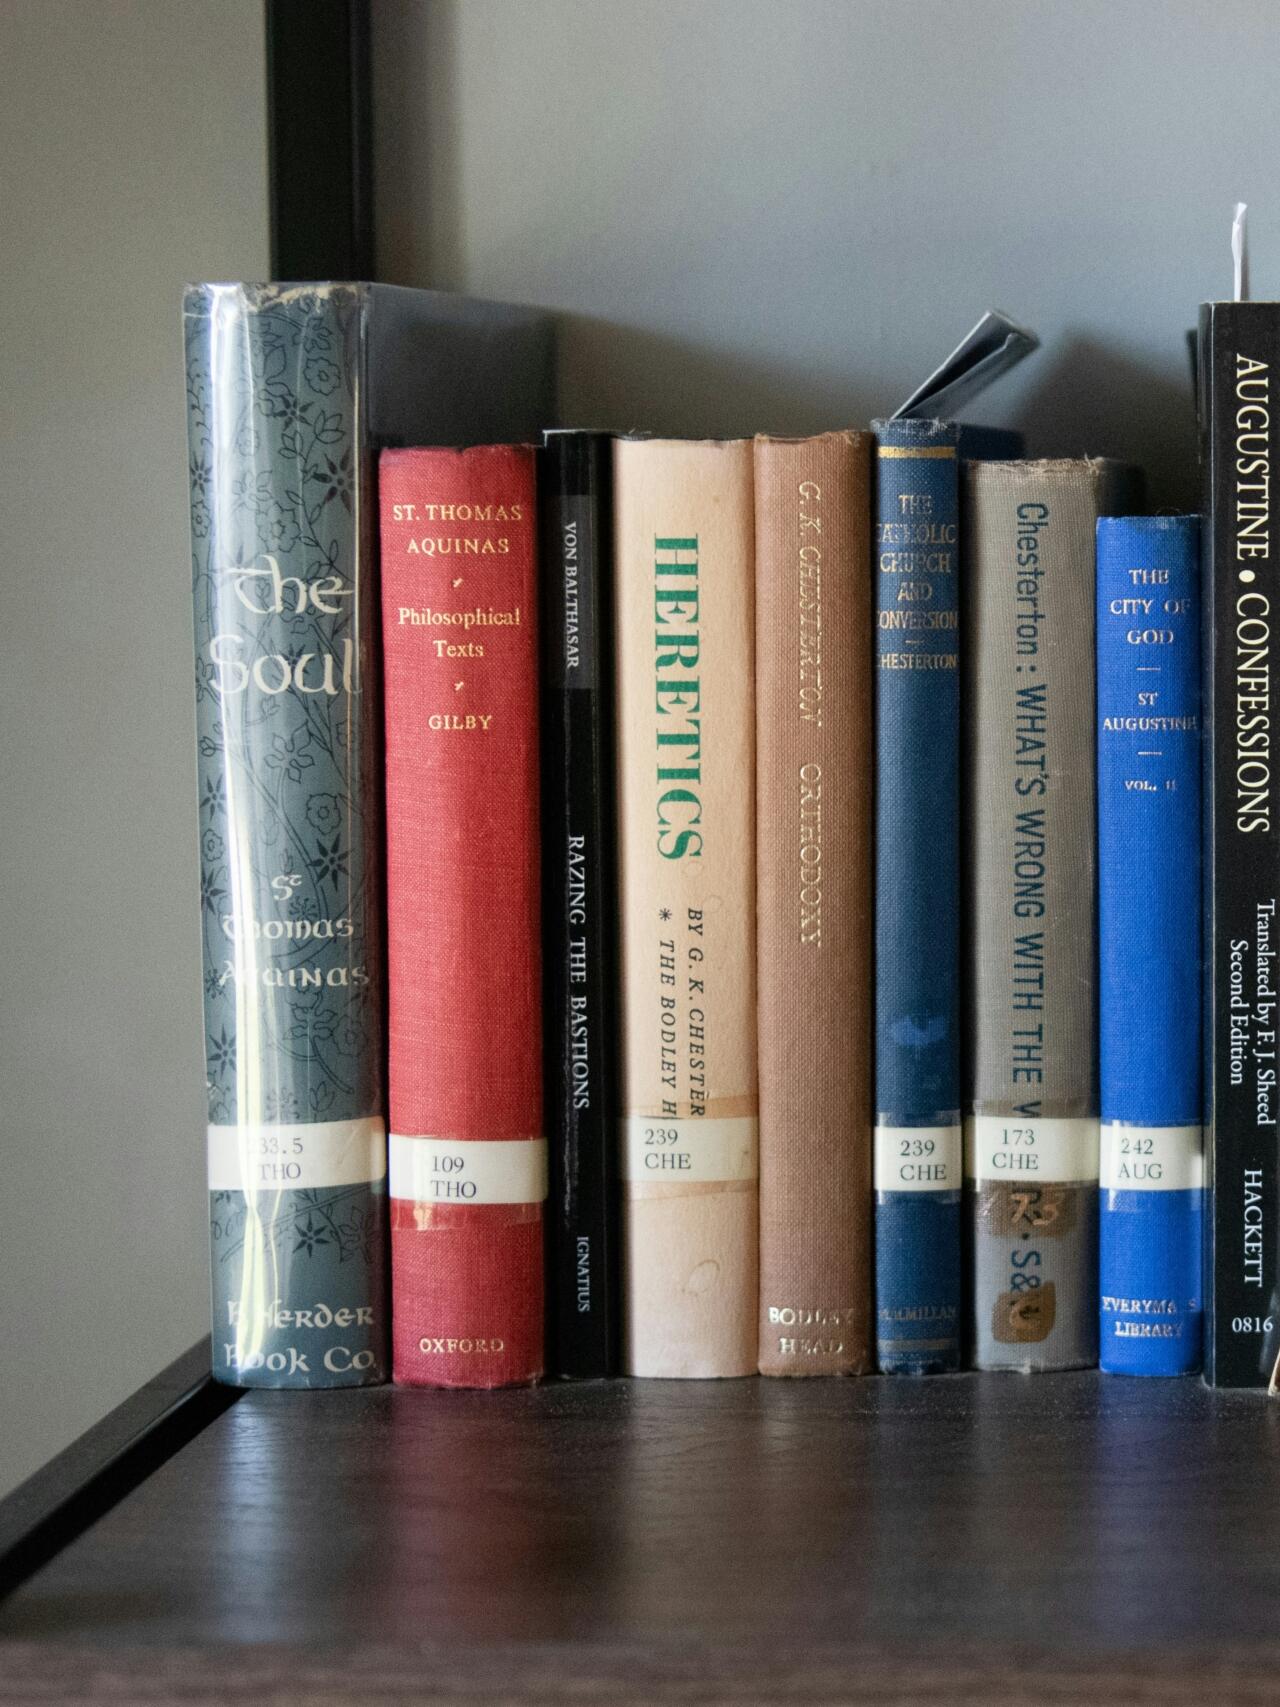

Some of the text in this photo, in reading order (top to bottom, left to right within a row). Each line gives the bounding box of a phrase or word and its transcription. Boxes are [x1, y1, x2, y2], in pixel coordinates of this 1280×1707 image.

[393, 504, 522, 521] ST. THOMAS
[898, 495, 933, 514] THE
[407, 538, 509, 555] AQUINAS
[879, 553, 951, 573] CHURCH
[1129, 569, 1168, 585] THE
[563, 521, 580, 669] VON BALTHASAR
[898, 582, 933, 601] AND
[1236, 353, 1270, 834] AUGUSTINE CONFESSIONS
[1110, 599, 1191, 614] CITY OF
[398, 607, 520, 629] Philosophical
[1127, 630, 1173, 644] GOD
[433, 640, 484, 658] Texts
[210, 634, 362, 696] Soul
[653, 532, 704, 861] HERETICS
[1138, 692, 1158, 705] ST
[428, 714, 493, 731] GILBY
[799, 481, 823, 948] G. K. CHESTERTON ORTHODOXY
[1103, 716, 1197, 730] AUGUSTINE
[1012, 684, 1047, 1084] WHAT'S WRONG WITH THE
[688, 908, 704, 969] BY G.
[568, 834, 590, 1109] RAZING THE BASTIONS
[660, 940, 677, 1089] THE BODLEY
[1229, 939, 1249, 1085] Second Edition
[1250, 899, 1277, 1127] Translated by F. J. Sheed
[645, 1129, 678, 1145] 239
[1001, 1129, 1035, 1145] 173
[900, 1140, 935, 1158] 239
[1121, 1138, 1154, 1155] 242
[431, 1155, 465, 1174] 109
[645, 1153, 691, 1169] CHE
[992, 1153, 1039, 1170] CHE
[900, 1163, 947, 1181] CHE
[1118, 1162, 1162, 1180] AUG
[430, 1180, 477, 1199] THO
[1244, 1169, 1263, 1287] HACKETT
[577, 1235, 590, 1312] IGNATIUS
[1115, 1321, 1183, 1337] LIBRARY
[1231, 1316, 1274, 1333] 0816
[419, 1337, 504, 1354] OXFORD
